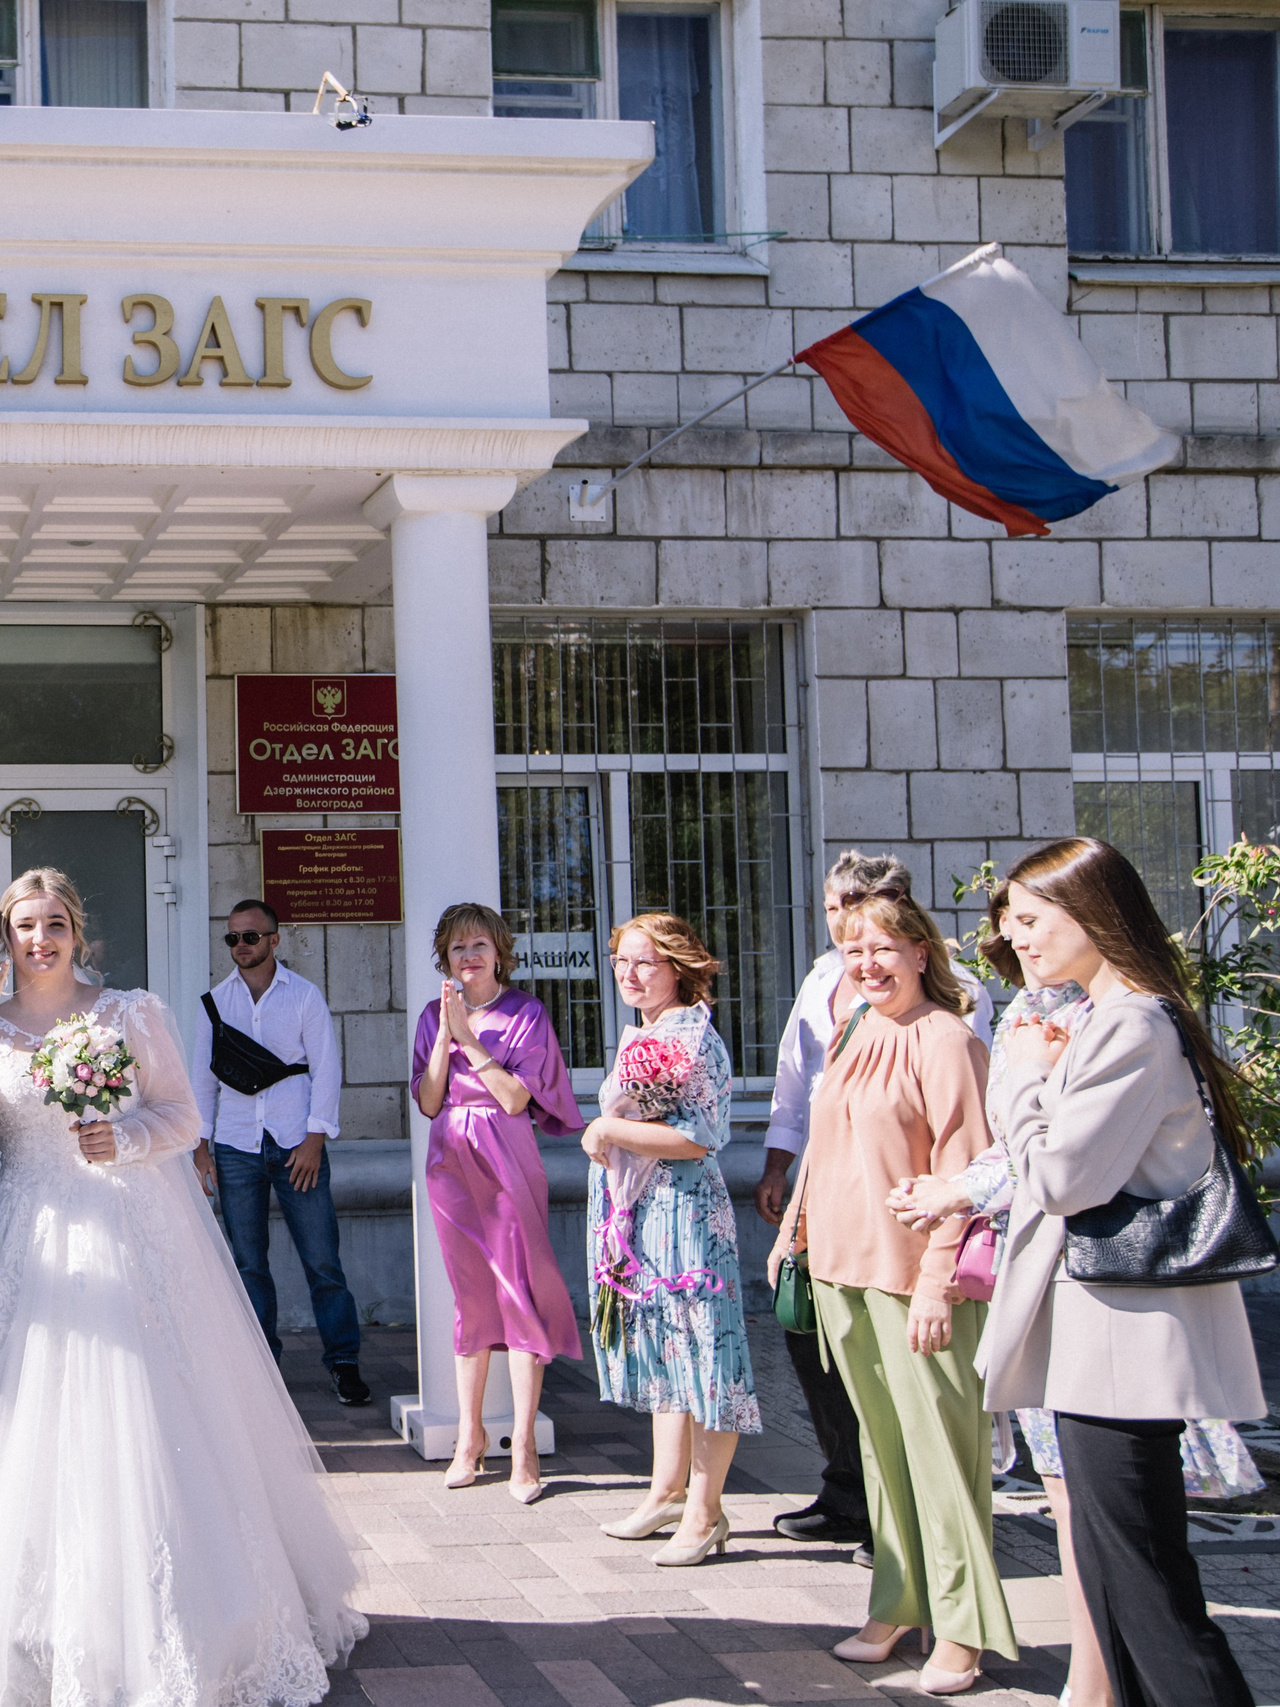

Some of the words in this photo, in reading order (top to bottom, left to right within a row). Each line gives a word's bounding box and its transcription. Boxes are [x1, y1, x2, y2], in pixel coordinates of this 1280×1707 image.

[121, 293, 373, 390] ЗАГС
[263, 721, 329, 732] Российская
[331, 721, 395, 733] Федерация
[249, 738, 335, 764] Отдел
[282, 774, 376, 784] администрации
[263, 785, 349, 796] Дзержинского
[351, 785, 395, 797] района
[296, 799, 363, 809] Волгограда
[304, 833, 332, 842] Отдел
[334, 833, 357, 841] ЗАГС
[298, 864, 329, 874] График
[331, 863, 364, 873] работы:
[265, 877, 343, 886] понедельник-пятница
[349, 876, 365, 884] 8.30
[286, 889, 318, 897] перерыв
[357, 887, 377, 895] 14.00
[290, 899, 320, 908] суббота
[354, 898, 374, 906] 17.00
[290, 910, 329, 919] выходной:
[330, 911, 374, 919] воскресенье
[516, 950, 590, 968] НАШИХ
